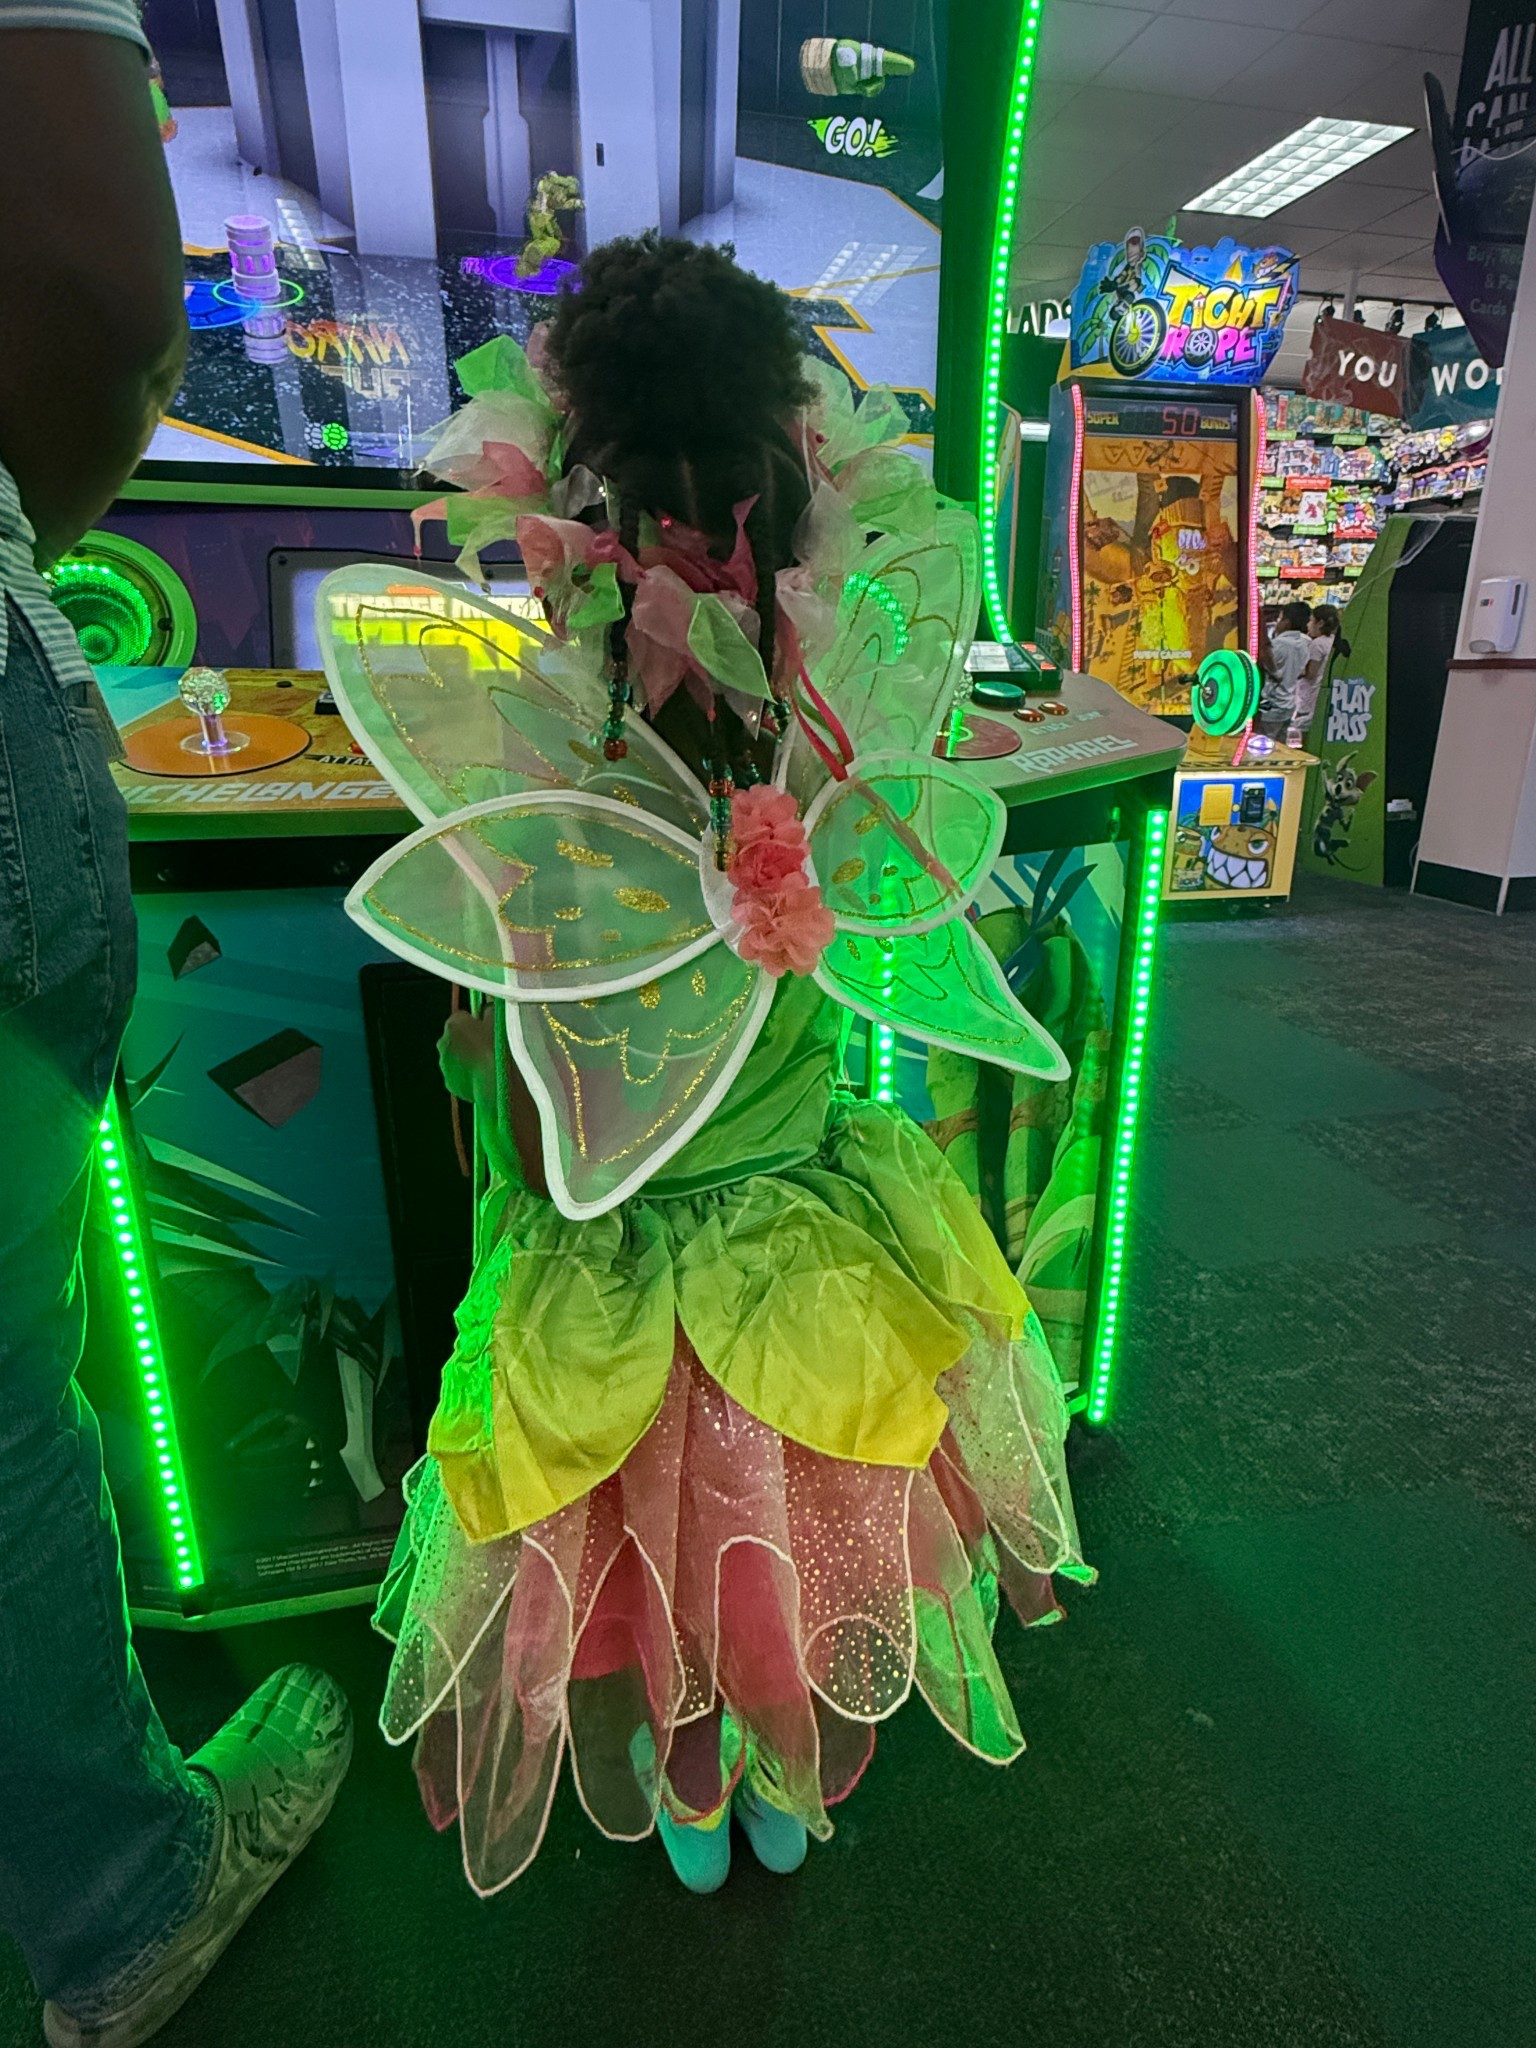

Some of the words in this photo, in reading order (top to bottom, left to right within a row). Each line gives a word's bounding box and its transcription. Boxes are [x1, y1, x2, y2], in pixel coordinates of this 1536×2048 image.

[1484, 22, 1535, 91] ALL
[825, 116, 882, 157] GO!
[1162, 265, 1282, 330] TIGHT
[1160, 324, 1258, 368] ROPE
[1337, 350, 1397, 388] YOU
[1162, 405, 1200, 436] 50
[1331, 679, 1376, 713] PLAY
[1327, 710, 1373, 743] PASS
[319, 755, 374, 767] ATTAC
[1006, 734, 1140, 774] RAPHAEL
[121, 780, 401, 804] ICHELANGE
